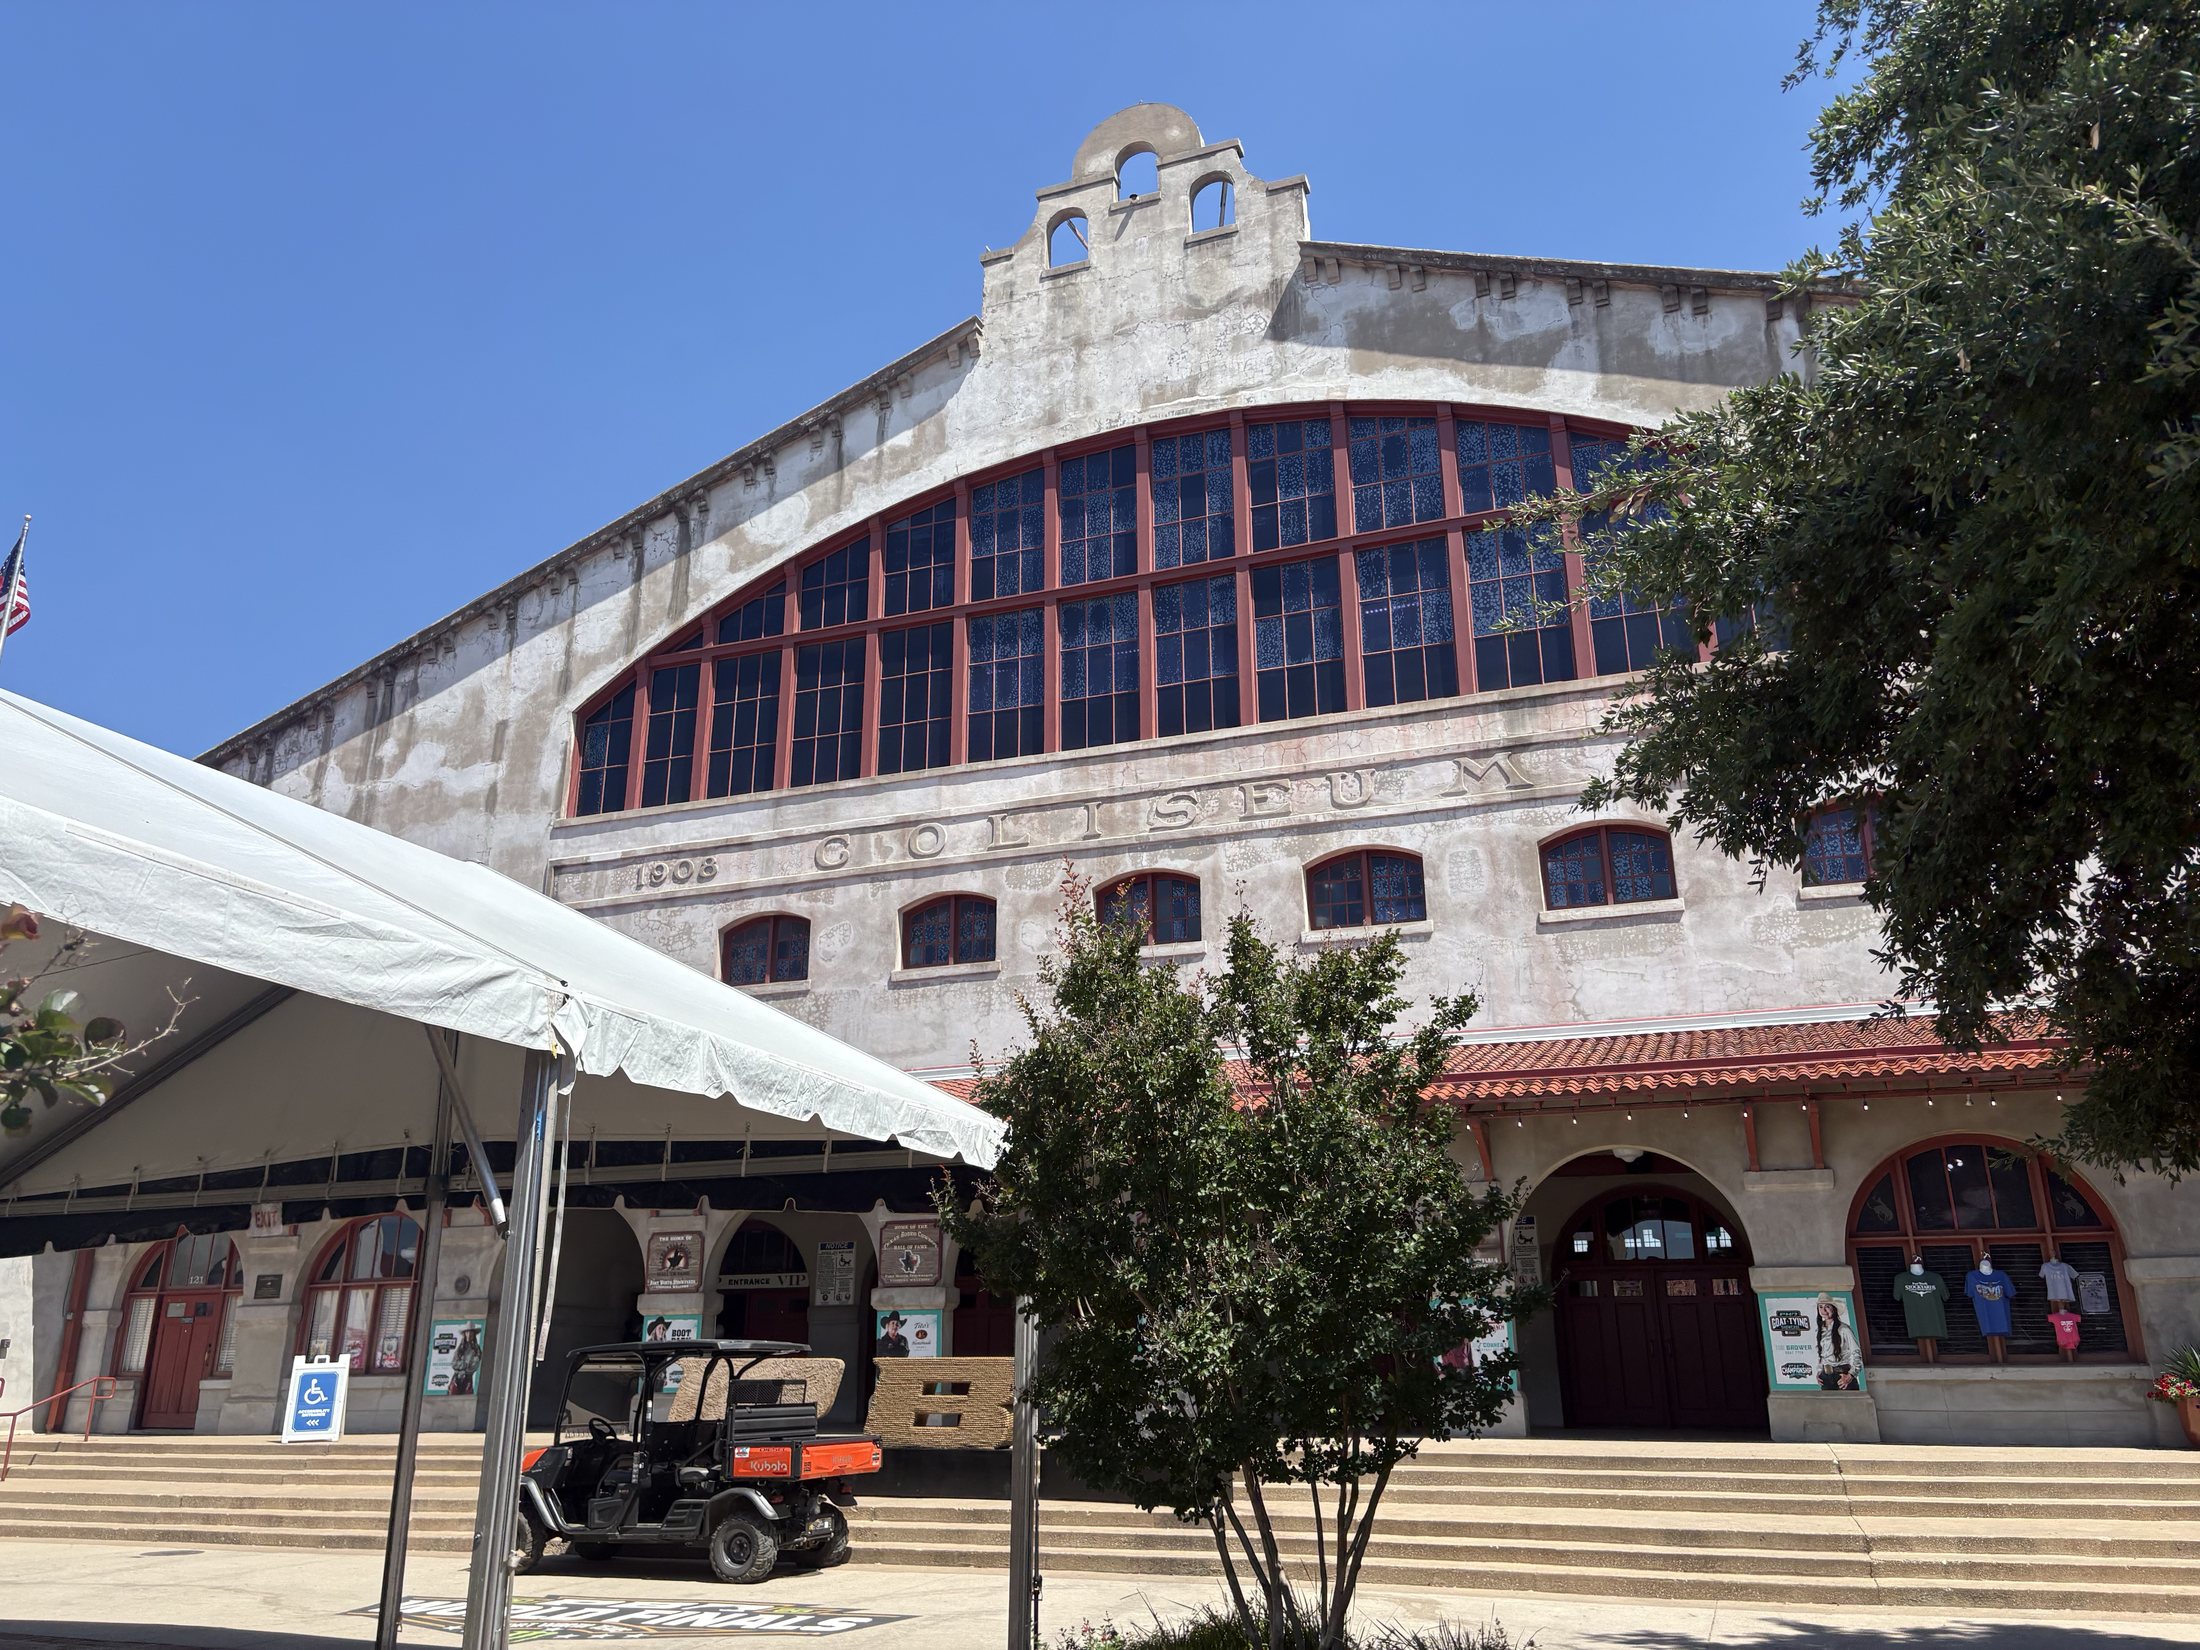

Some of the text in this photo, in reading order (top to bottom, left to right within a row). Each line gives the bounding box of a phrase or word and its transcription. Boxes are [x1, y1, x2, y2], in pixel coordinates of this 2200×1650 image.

[814, 751, 1534, 871] COLISEUM
[635, 855, 720, 890] 1908
[254, 1210, 278, 1228] EXIT
[189, 1275, 205, 1285] 121
[728, 1274, 807, 1287] ENTRANCE VIP
[914, 1321, 930, 1329] Tito's
[1771, 1317, 1809, 1329] GOAT TYING
[671, 1329, 692, 1337] BOOT
[750, 1460, 788, 1472] Kubota
[601, 1608, 873, 1632] FINALS
